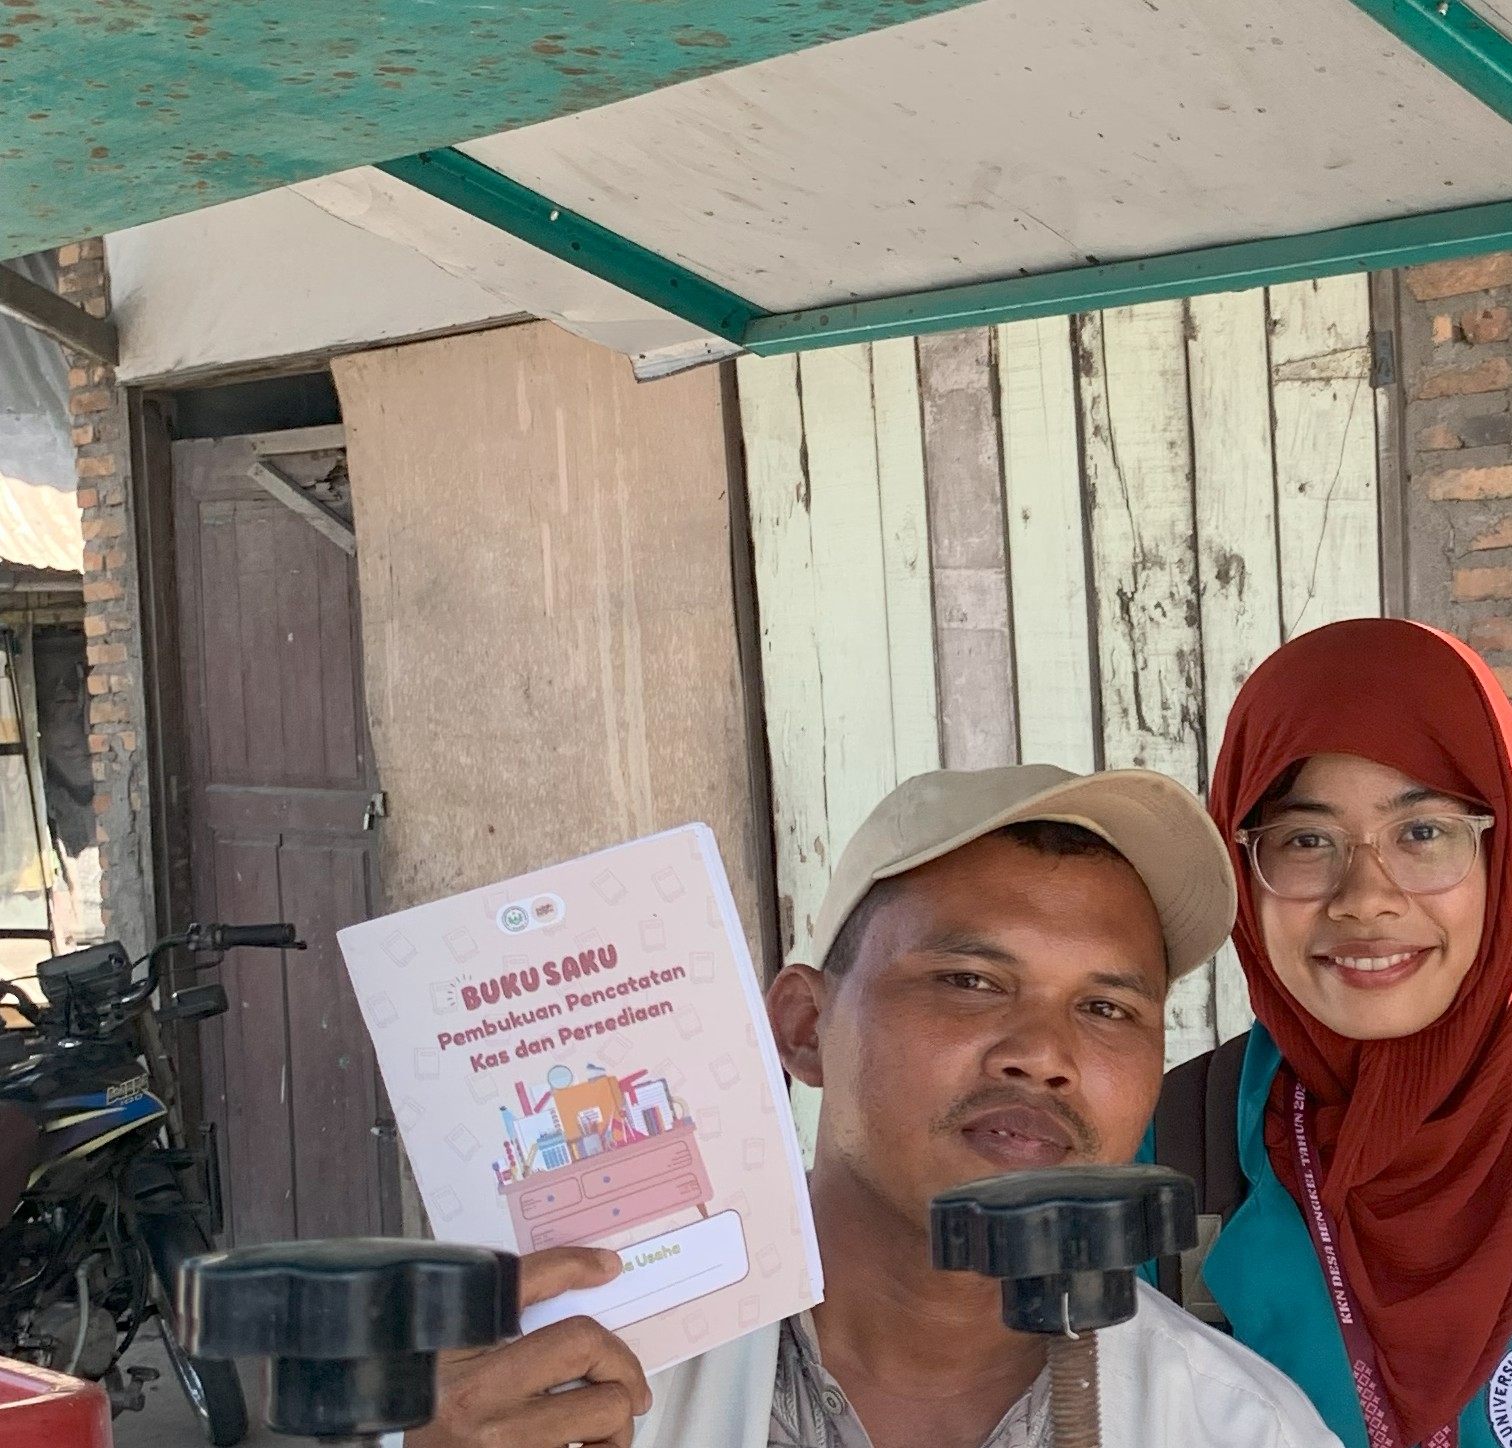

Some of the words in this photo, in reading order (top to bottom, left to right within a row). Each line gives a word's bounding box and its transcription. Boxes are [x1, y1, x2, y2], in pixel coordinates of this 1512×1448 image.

[461, 966, 541, 1011] BUKU
[542, 943, 618, 986] SAKU
[437, 1002, 562, 1051] Pembukuan
[565, 965, 687, 1012] Pencatatan
[470, 1049, 511, 1073] Kas
[515, 1035, 556, 1059] dan
[558, 1000, 674, 1046] Persediaan
[1293, 1082, 1306, 1110] 202
[1294, 1113, 1310, 1167] TAHUN
[635, 1243, 681, 1267] Usaha
[1324, 1245, 1343, 1288] DESA
[1334, 1290, 1353, 1324] KKN
